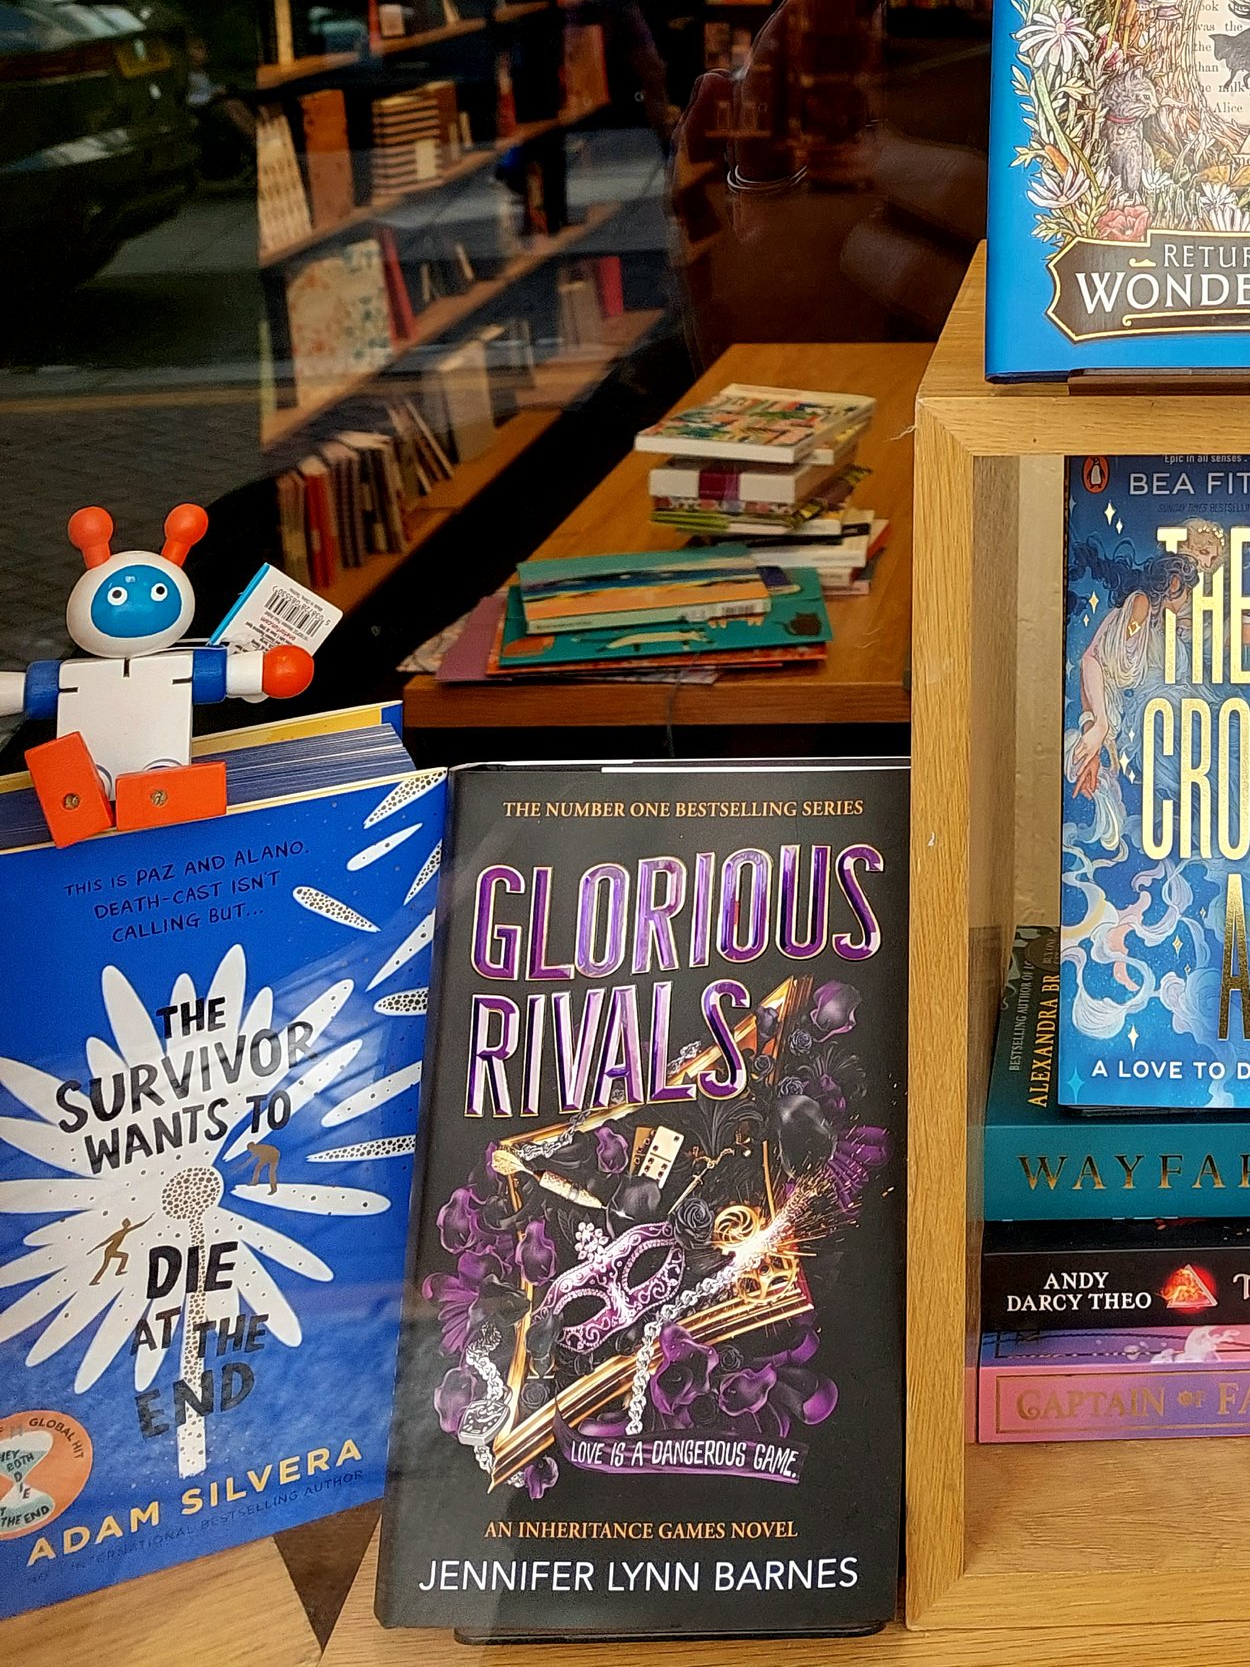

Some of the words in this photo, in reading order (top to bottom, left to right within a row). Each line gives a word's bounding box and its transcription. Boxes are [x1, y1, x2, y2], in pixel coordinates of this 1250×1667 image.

[503, 802, 542, 817] THE
[545, 802, 626, 817] NUMBER
[630, 802, 670, 817] ONE
[675, 800, 797, 817] BESTSELLING
[802, 800, 864, 816] SERIES
[470, 843, 885, 981] GLORIOUS
[156, 997, 226, 1039] THE
[464, 978, 750, 1117] RIVALS
[55, 1020, 316, 1134] SURVIVOR
[1092, 1060, 1108, 1079] A
[1118, 1060, 1183, 1080] LOVE
[1193, 1061, 1226, 1080] TO
[84, 1098, 229, 1176] WANTS
[246, 1090, 292, 1134] TO
[146, 1241, 239, 1299] DIE
[1045, 1271, 1109, 1291] ANDY
[1007, 1292, 1084, 1313] DARCY
[1089, 1290, 1152, 1311] THEO
[131, 1306, 181, 1356] AT
[194, 1314, 269, 1359] THE
[135, 1361, 255, 1440] END
[1015, 1385, 1165, 1422] CAPTAIN
[571, 1440, 603, 1466] LOVE
[610, 1442, 626, 1466] IS
[631, 1442, 644, 1467] A
[651, 1440, 746, 1468] DANGEROUS
[754, 1442, 799, 1478] GAME.
[27, 1501, 159, 1566] ADAM
[181, 1438, 363, 1515] SILVERA
[485, 1522, 514, 1538] AN
[518, 1522, 653, 1539] INHERITANCE
[659, 1522, 725, 1538] GAMES
[731, 1521, 797, 1538] NOVEL
[419, 1561, 594, 1591] JENNIFER
[607, 1562, 700, 1591] LYNN
[715, 1557, 858, 1591] BARNES
